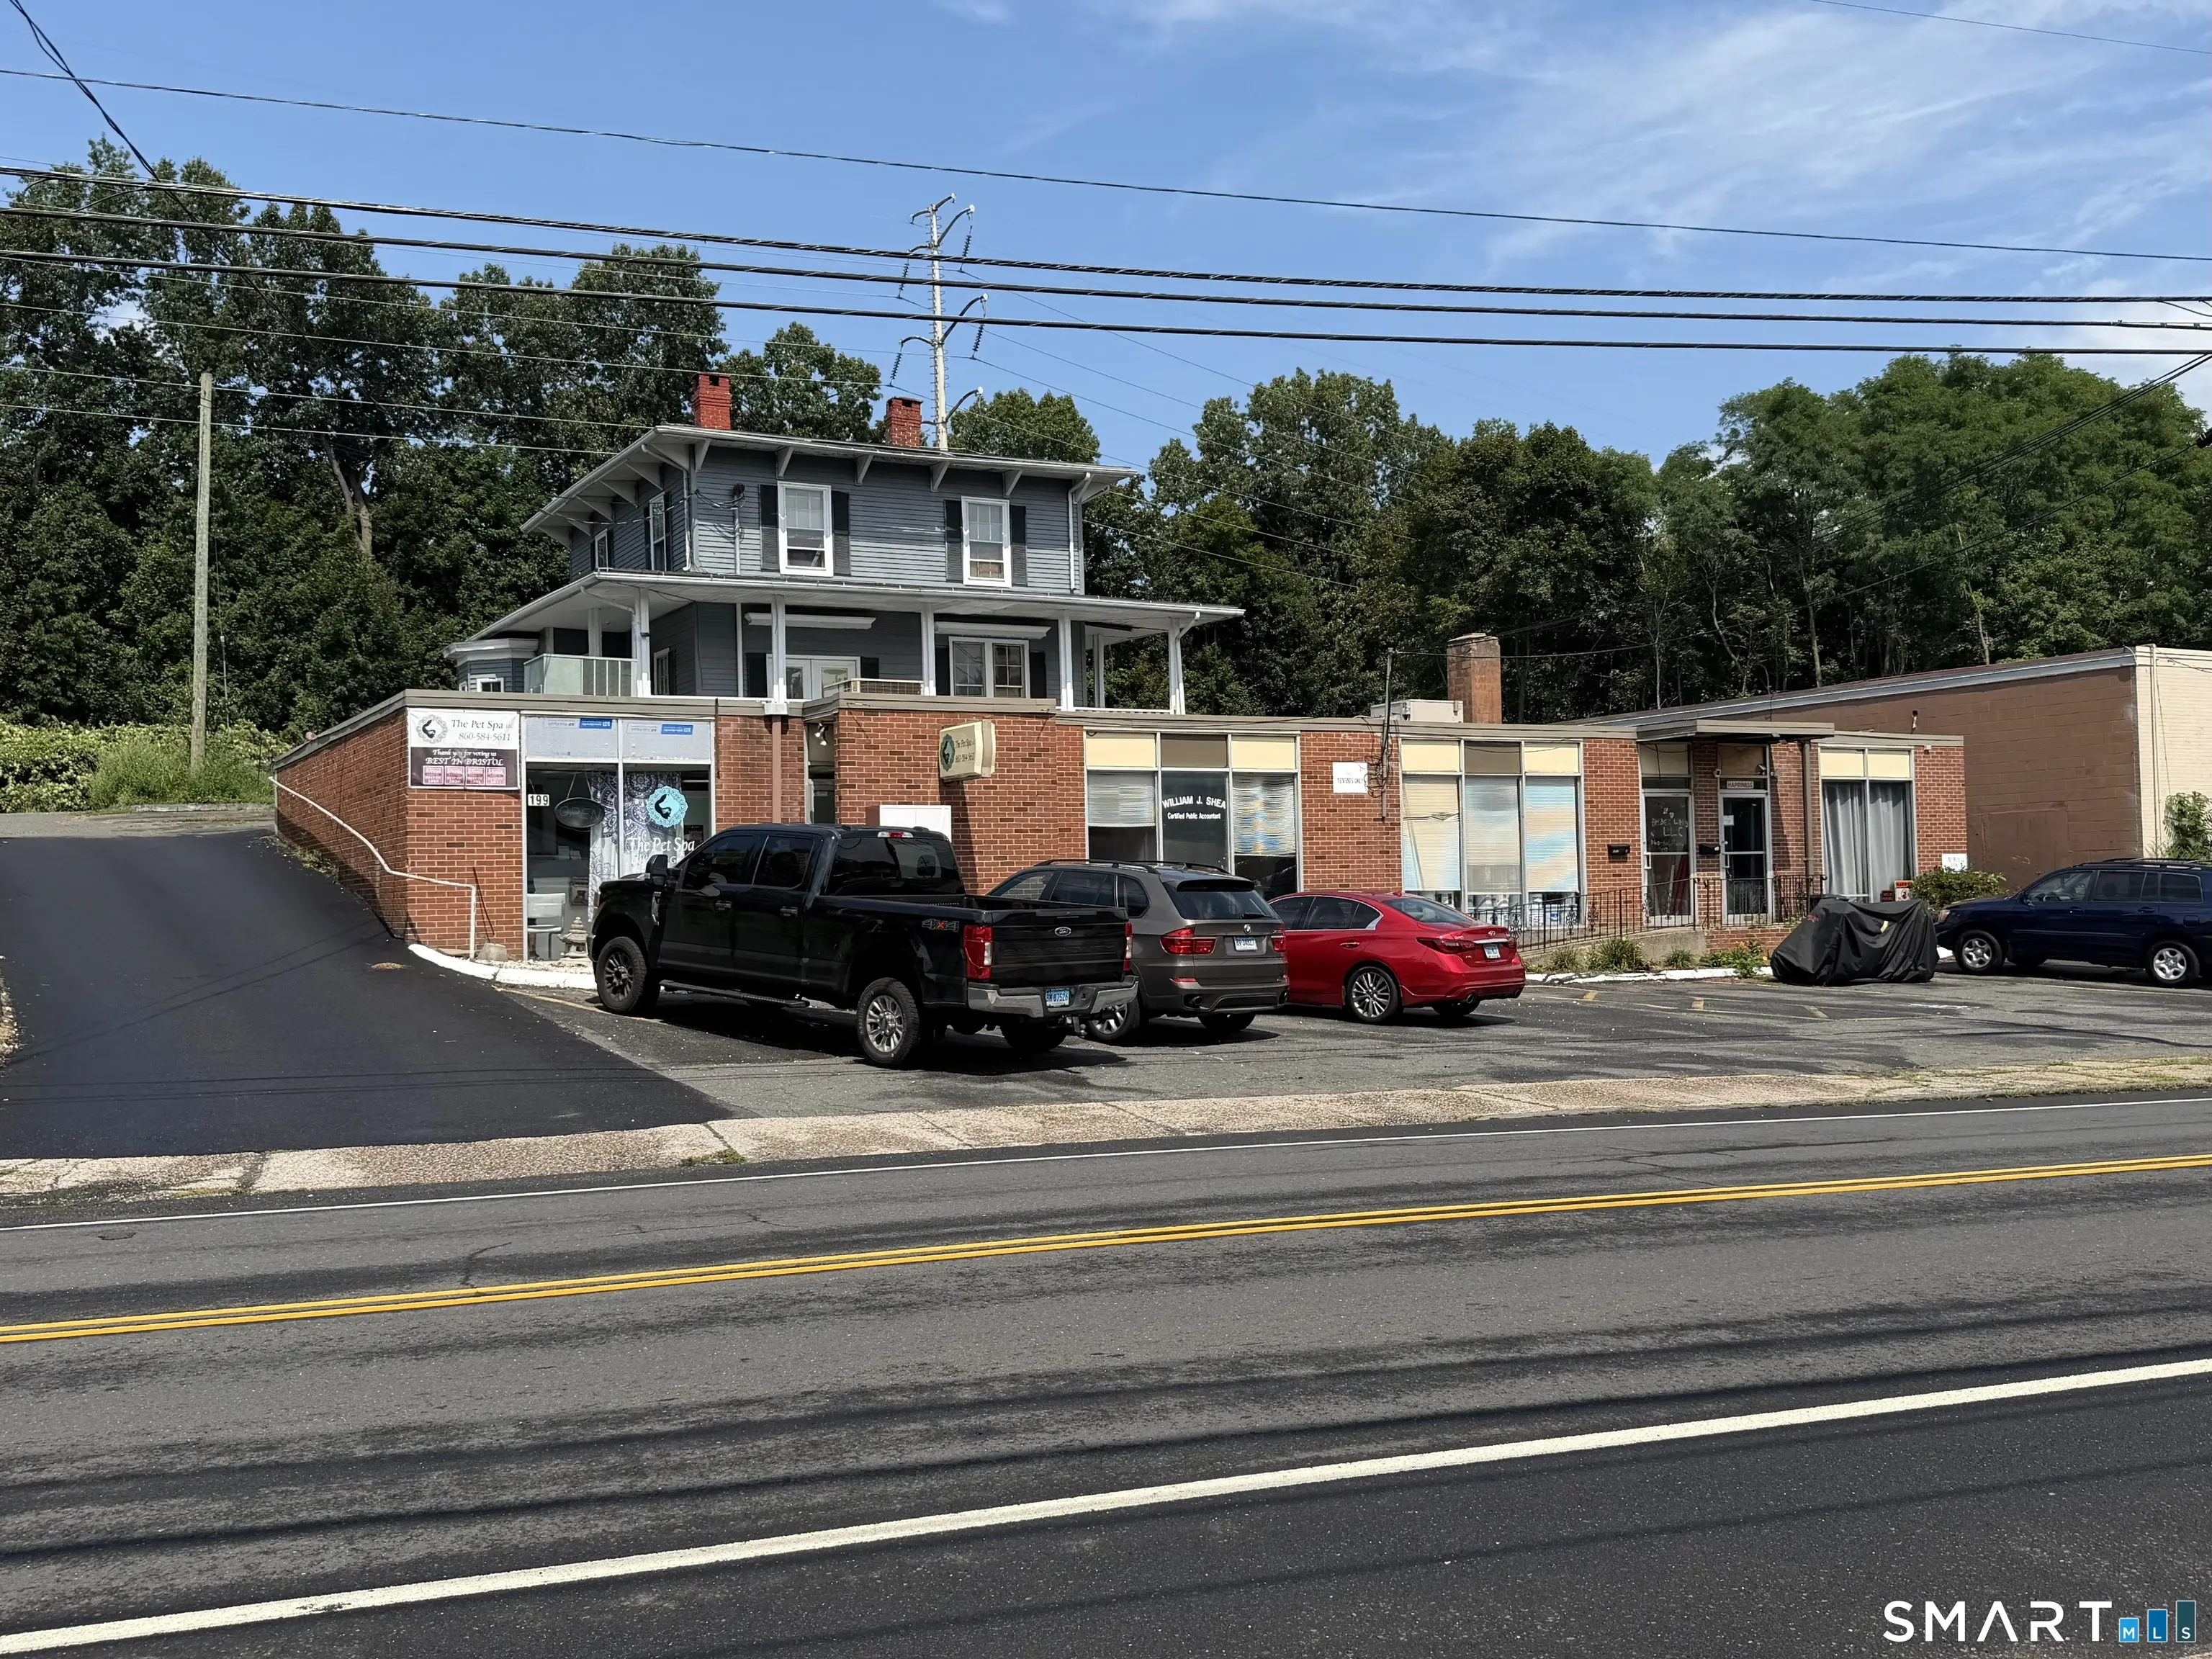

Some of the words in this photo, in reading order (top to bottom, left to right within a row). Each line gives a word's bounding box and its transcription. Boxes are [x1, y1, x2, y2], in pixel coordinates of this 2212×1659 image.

[451, 719, 469, 729] The
[471, 719, 485, 729] Pet
[487, 721, 504, 731] Spa
[458, 732, 511, 742] 860-584-5611
[472, 750, 490, 759] voting
[464, 757, 504, 766] BRISTOL
[530, 795, 549, 806] 199
[1161, 795, 1194, 809] WILLIAM
[1196, 796, 1203, 805] J.
[1205, 796, 1226, 809] SHEA
[559, 805, 602, 821] OPEN
[628, 837, 650, 851] The
[652, 837, 672, 852] Pet
[673, 837, 696, 856] Spa
